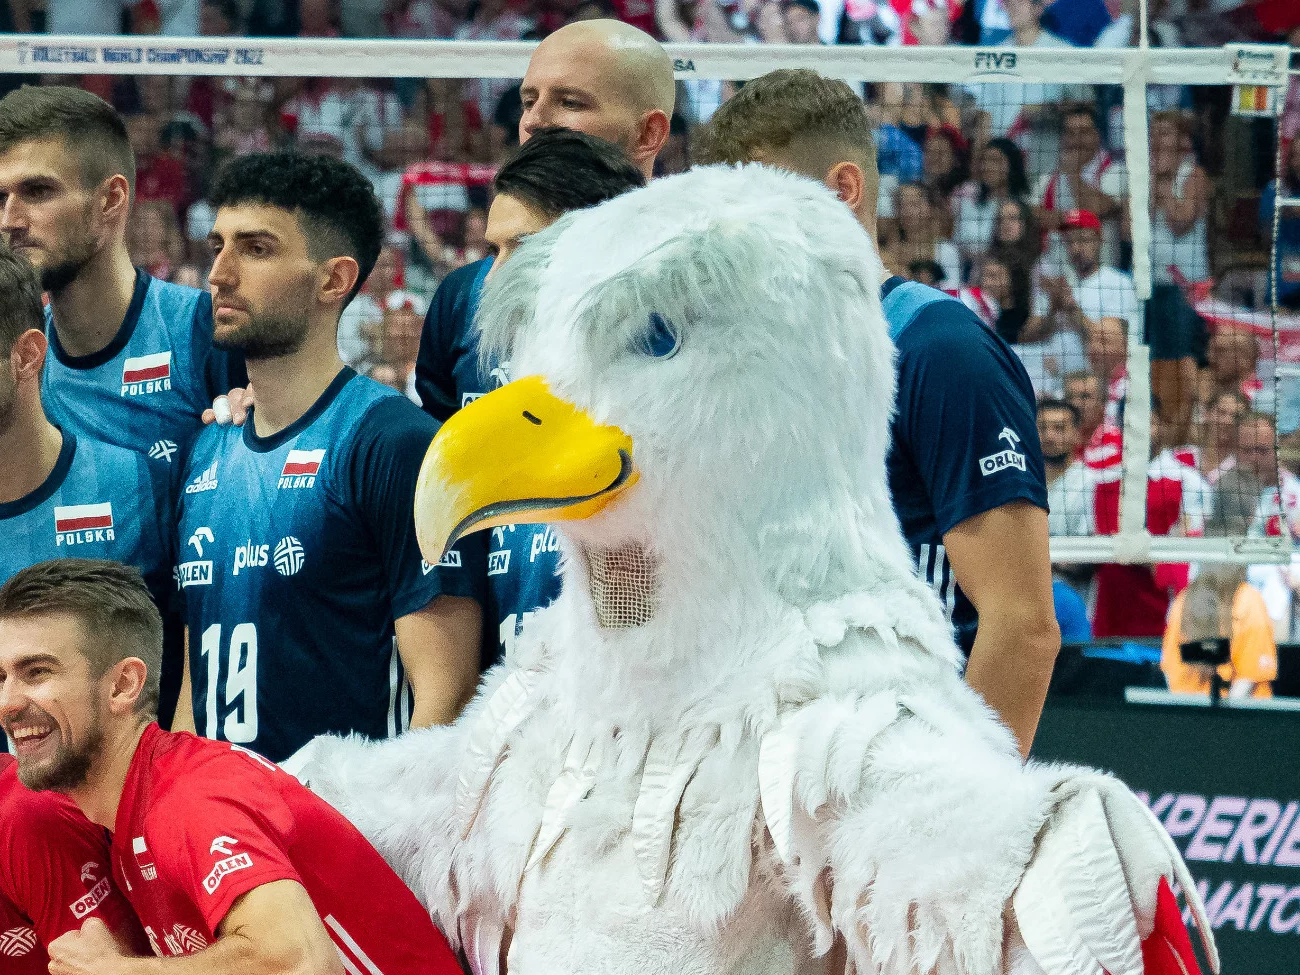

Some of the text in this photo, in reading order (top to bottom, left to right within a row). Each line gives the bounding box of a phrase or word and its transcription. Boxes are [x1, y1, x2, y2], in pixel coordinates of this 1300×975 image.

[975, 52, 1017, 69] FIVB
[120, 379, 172, 397] POLSKA
[984, 452, 1023, 471] ORLEN
[185, 479, 219, 494] adidas
[277, 478, 316, 490] POLSKA
[56, 529, 116, 547] POLSKA
[530, 525, 560, 563] plu
[233, 539, 270, 576] plus
[201, 623, 258, 744] 19
[208, 855, 248, 889] ORLEN
